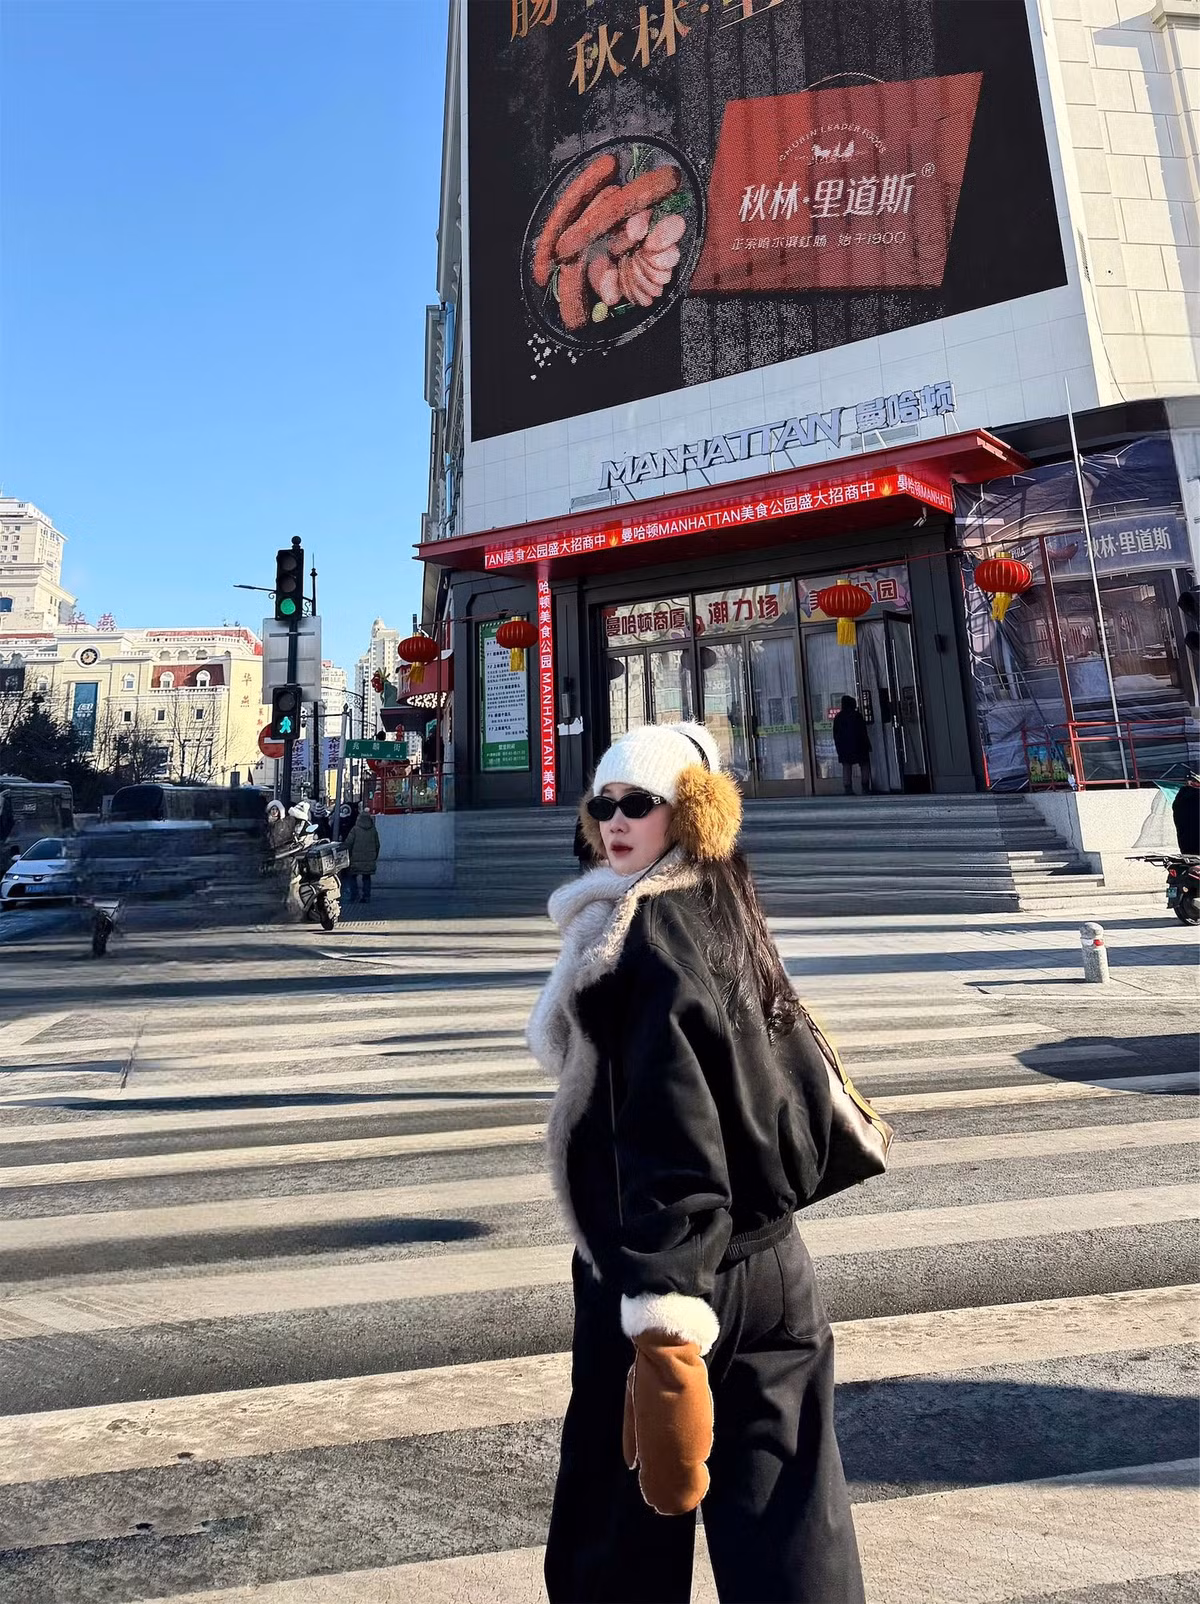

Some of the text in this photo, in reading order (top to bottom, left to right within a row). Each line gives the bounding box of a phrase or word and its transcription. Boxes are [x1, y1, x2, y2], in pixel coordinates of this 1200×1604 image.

[598, 380, 955, 490] MANHATTAN 曼哈顿
[621, 481, 875, 543] 曼哈顿MANHATTAN美食公园盛大招商中
[606, 607, 686, 637] 曼哈顿商厦
[708, 594, 779, 625] 潮力场
[542, 672, 554, 765] MANHATTAN
[543, 771, 555, 801] 美食
